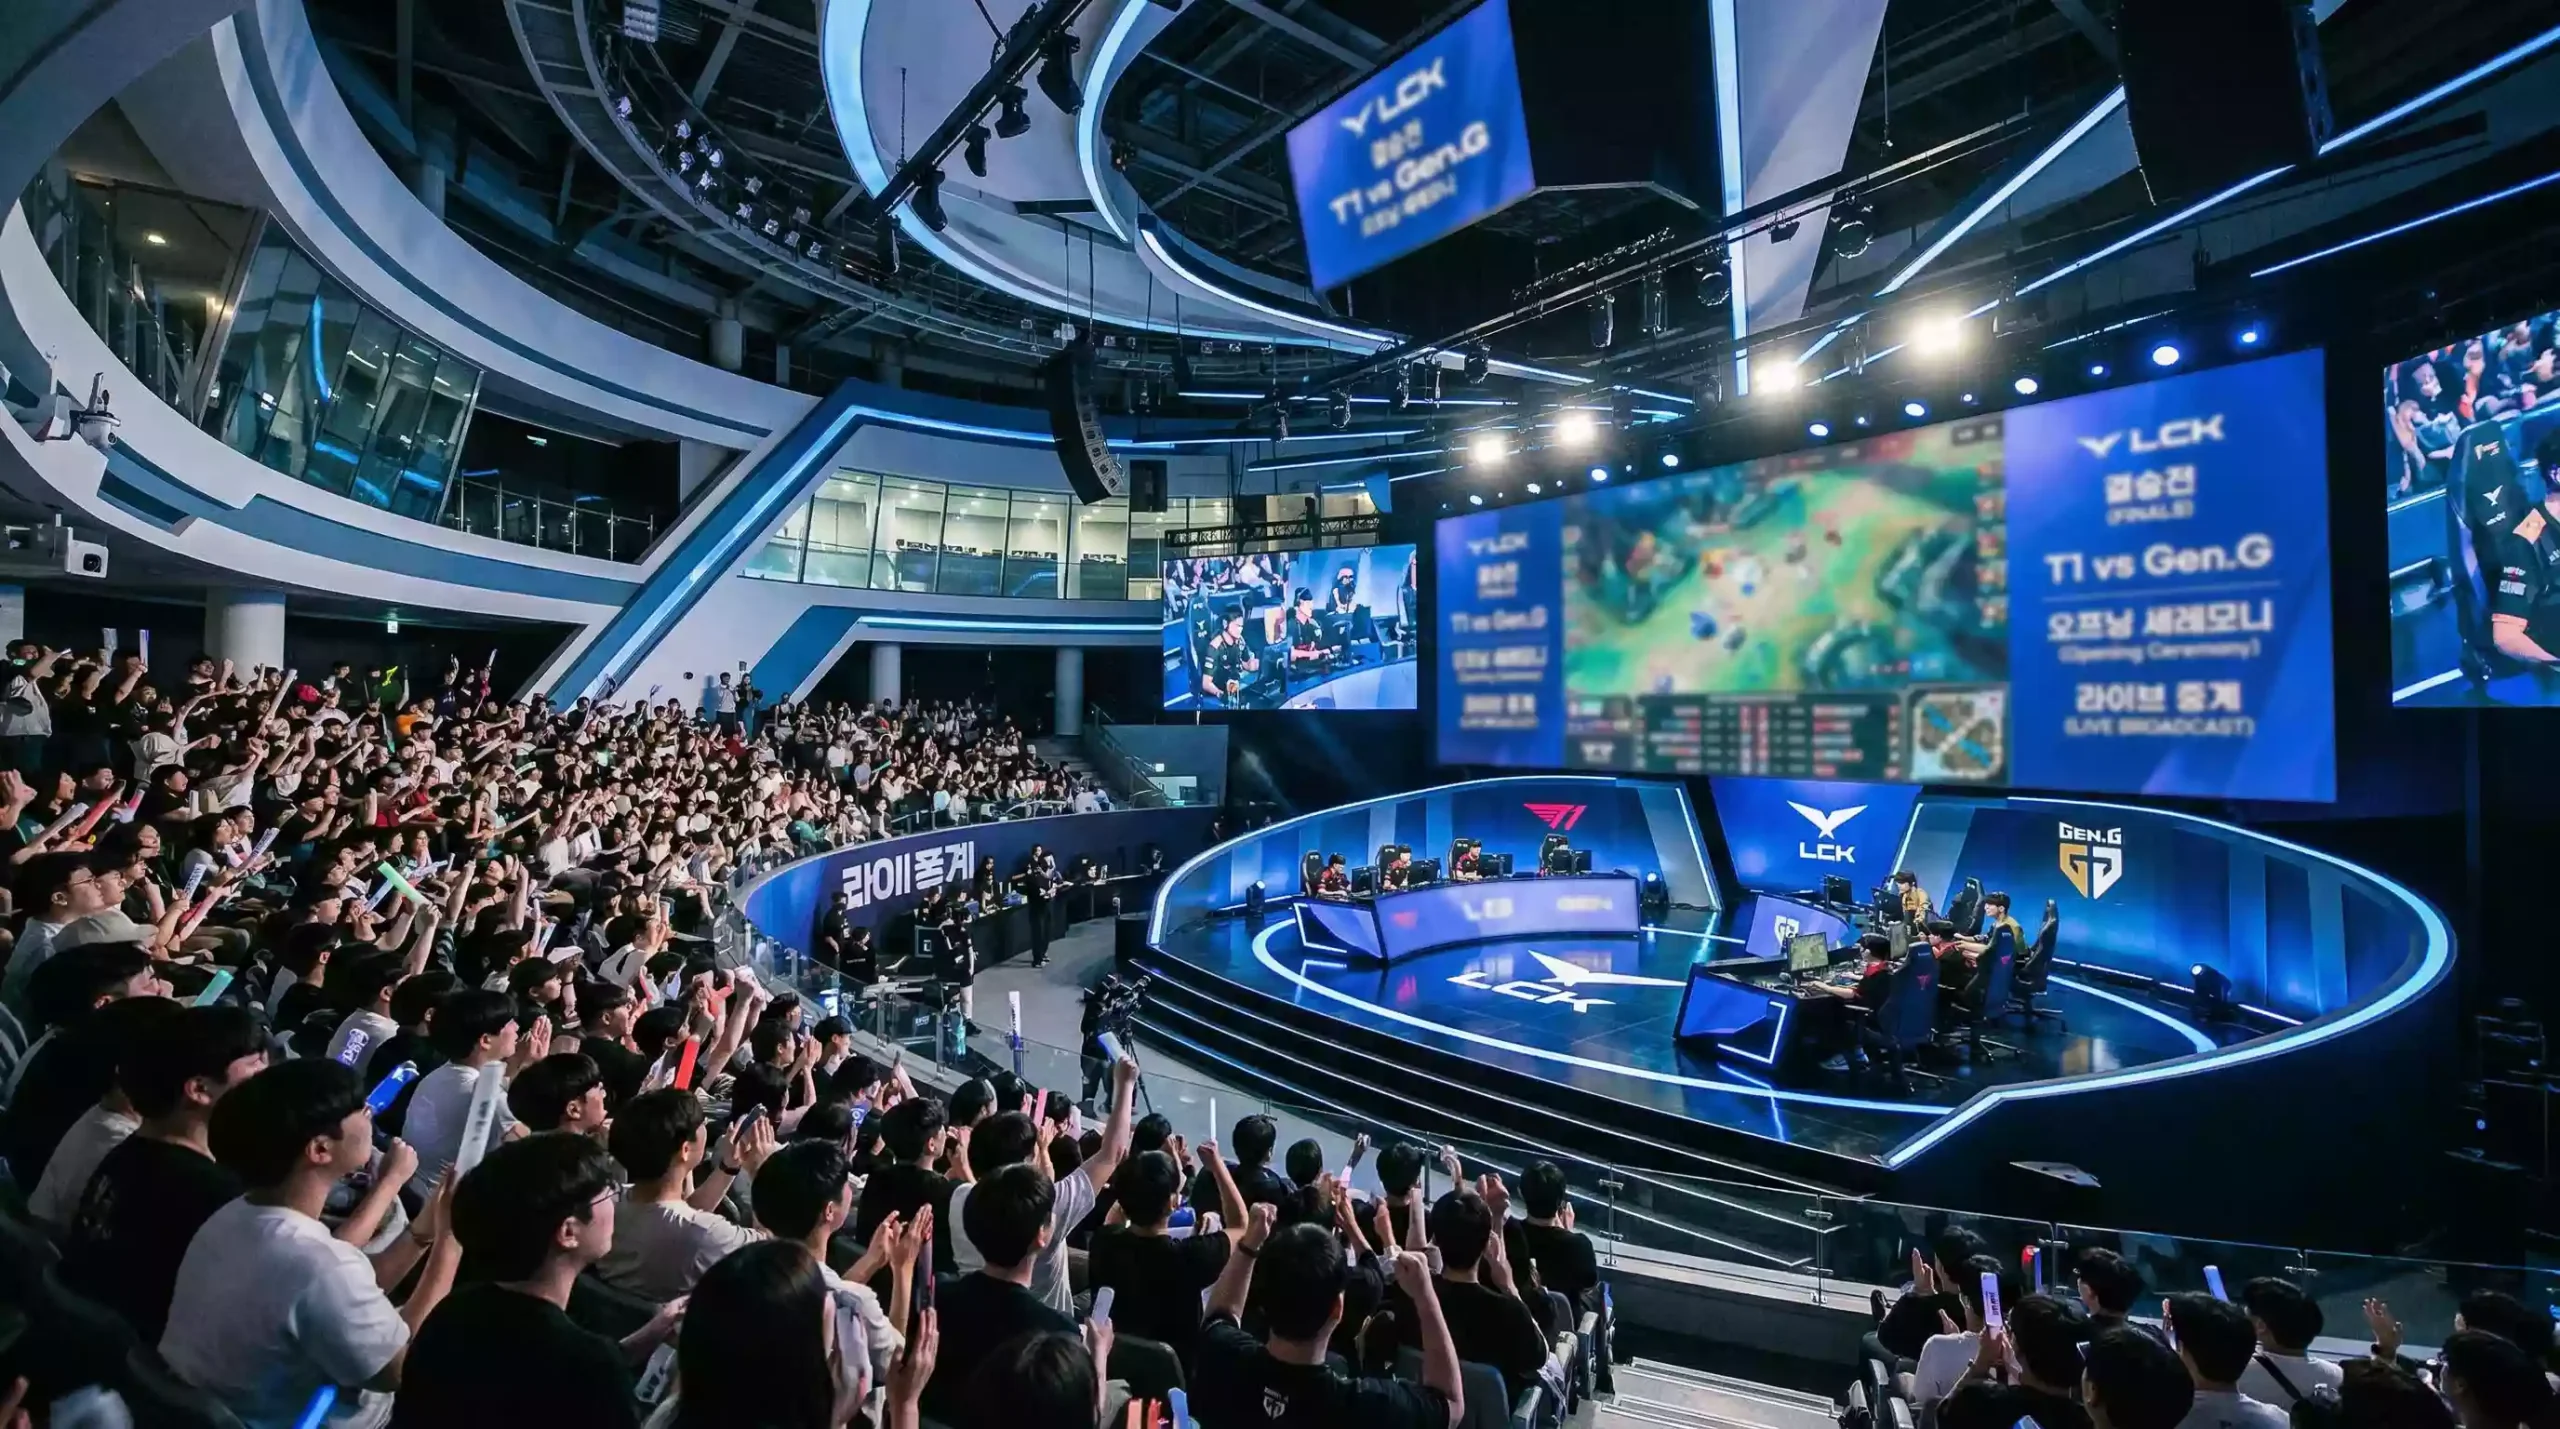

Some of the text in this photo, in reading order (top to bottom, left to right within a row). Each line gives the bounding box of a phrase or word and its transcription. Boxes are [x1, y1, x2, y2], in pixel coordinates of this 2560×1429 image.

[2129, 414, 2225, 454] LCK
[2045, 533, 2273, 584] T1 vs Gen.G
[2076, 683, 2166, 713] 라이브
[2059, 821, 2122, 845] GEN.G
[1799, 842, 1855, 863] LCK
